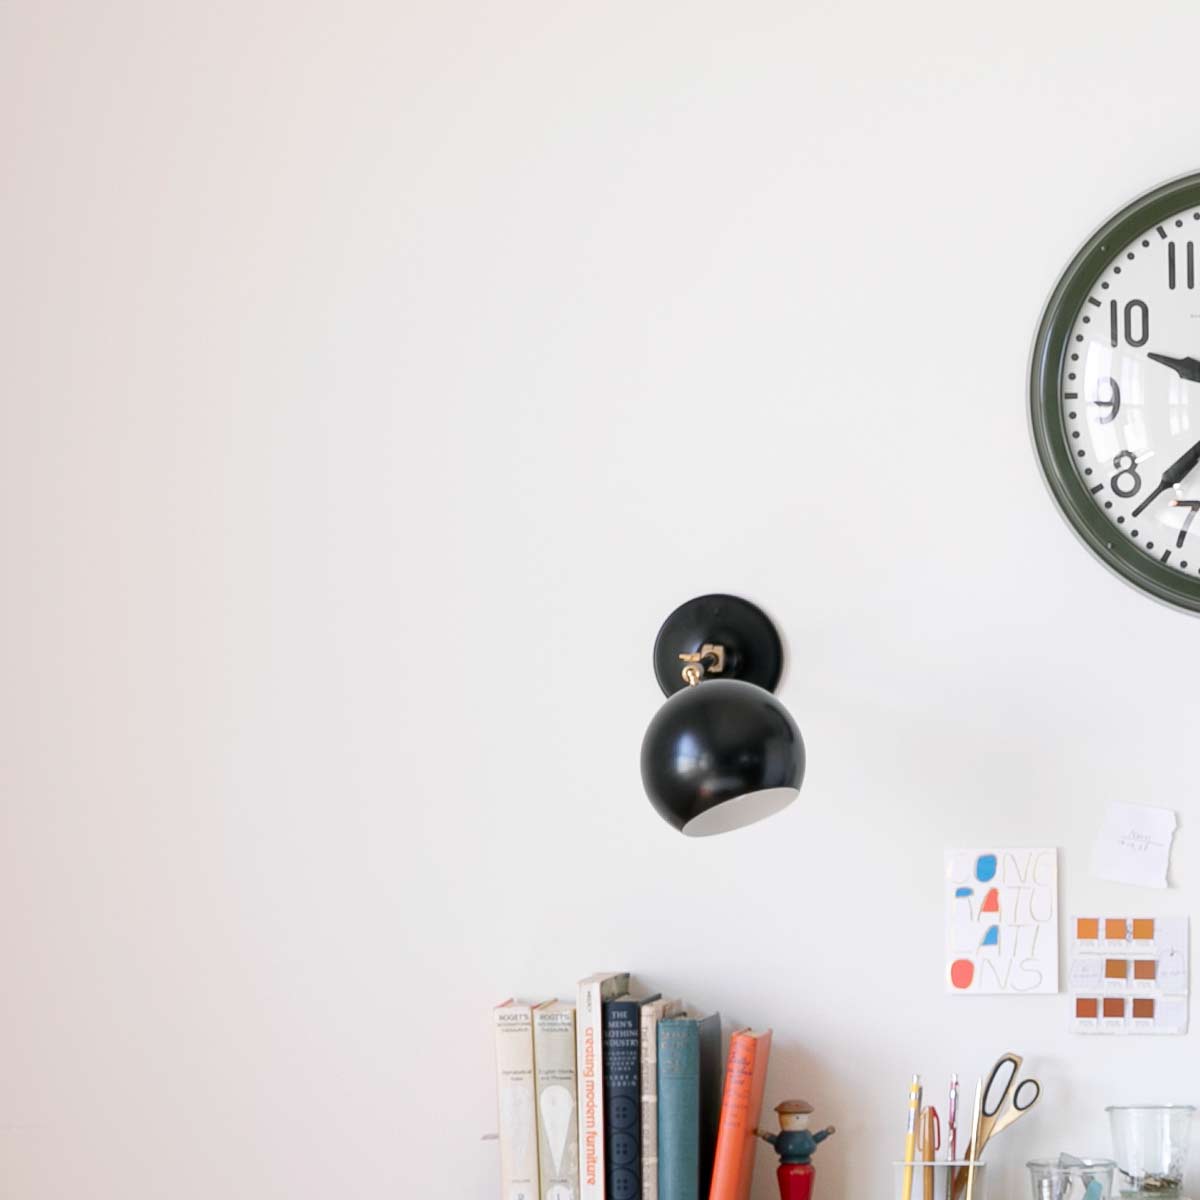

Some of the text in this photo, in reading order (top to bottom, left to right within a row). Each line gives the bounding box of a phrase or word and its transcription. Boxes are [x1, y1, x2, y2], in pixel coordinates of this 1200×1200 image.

[1168, 241, 1195, 290] 11
[1111, 299, 1149, 348] 10
[1093, 377, 1121, 424] 9
[1111, 450, 1142, 499] 8
[608, 1020, 633, 1029] MEN'S
[611, 1010, 628, 1019] THE
[583, 1027, 597, 1185] creating modern furniture
